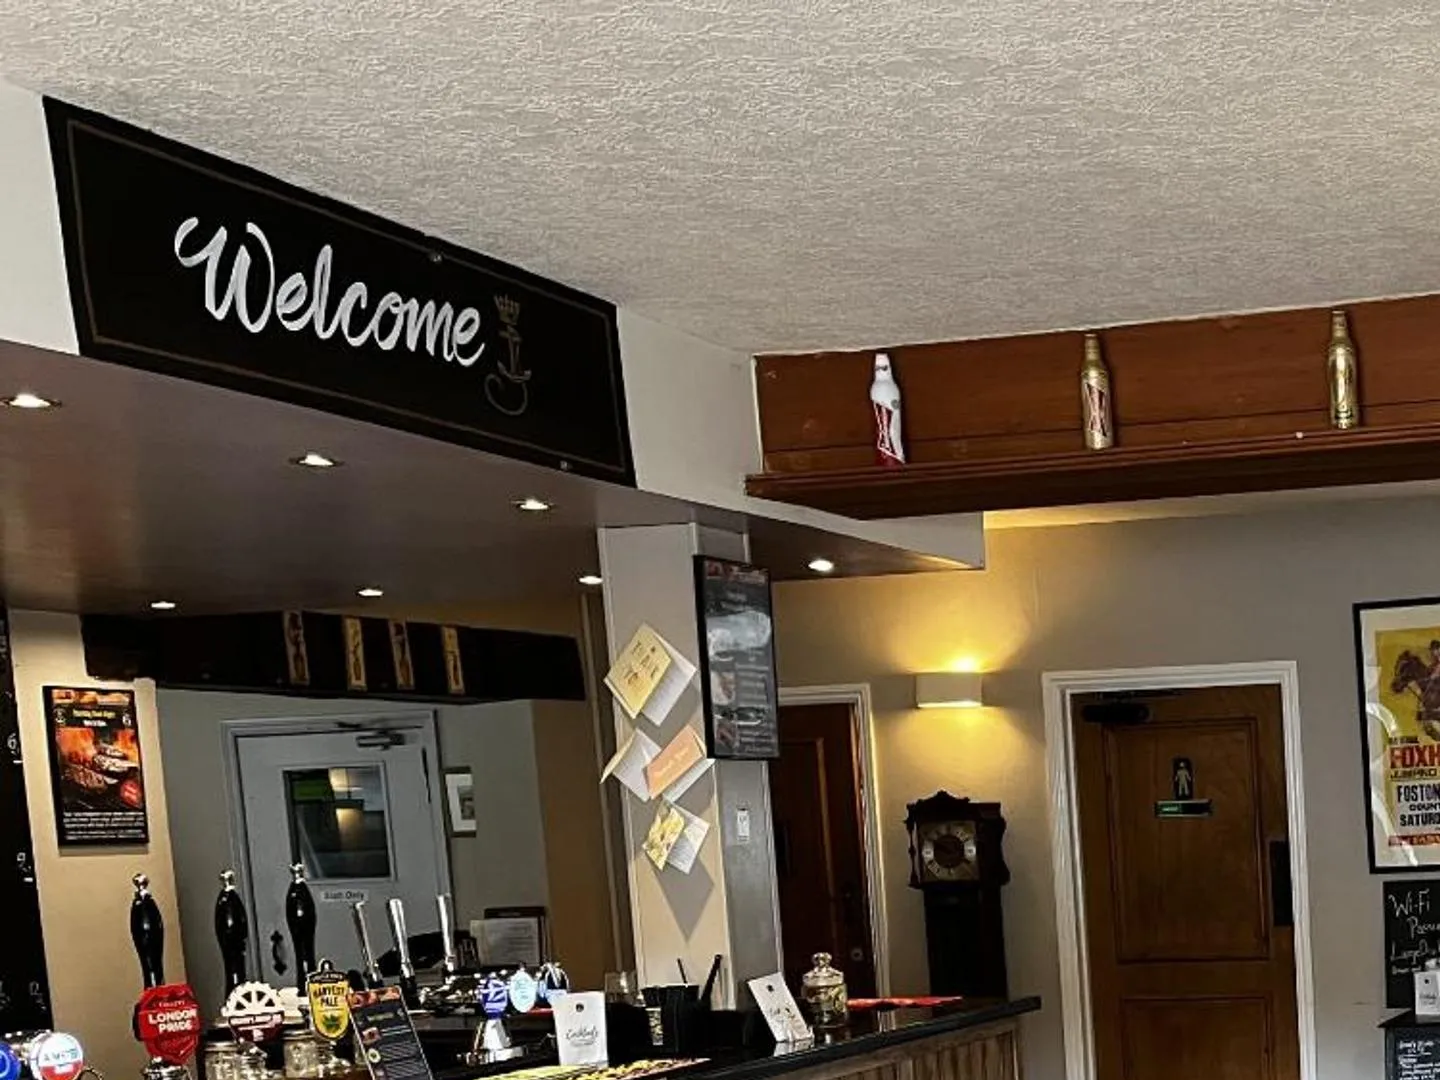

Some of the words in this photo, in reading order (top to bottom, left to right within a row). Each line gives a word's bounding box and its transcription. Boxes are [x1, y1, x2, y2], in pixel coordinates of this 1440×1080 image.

[174, 217, 485, 366] Welcome
[1397, 783, 1440, 803] FOSTON
[1388, 888, 1430, 917] Wi-Fi
[320, 995, 339, 1007] PALE
[148, 1008, 198, 1025] LONDON
[158, 1020, 193, 1034] PRIDE
